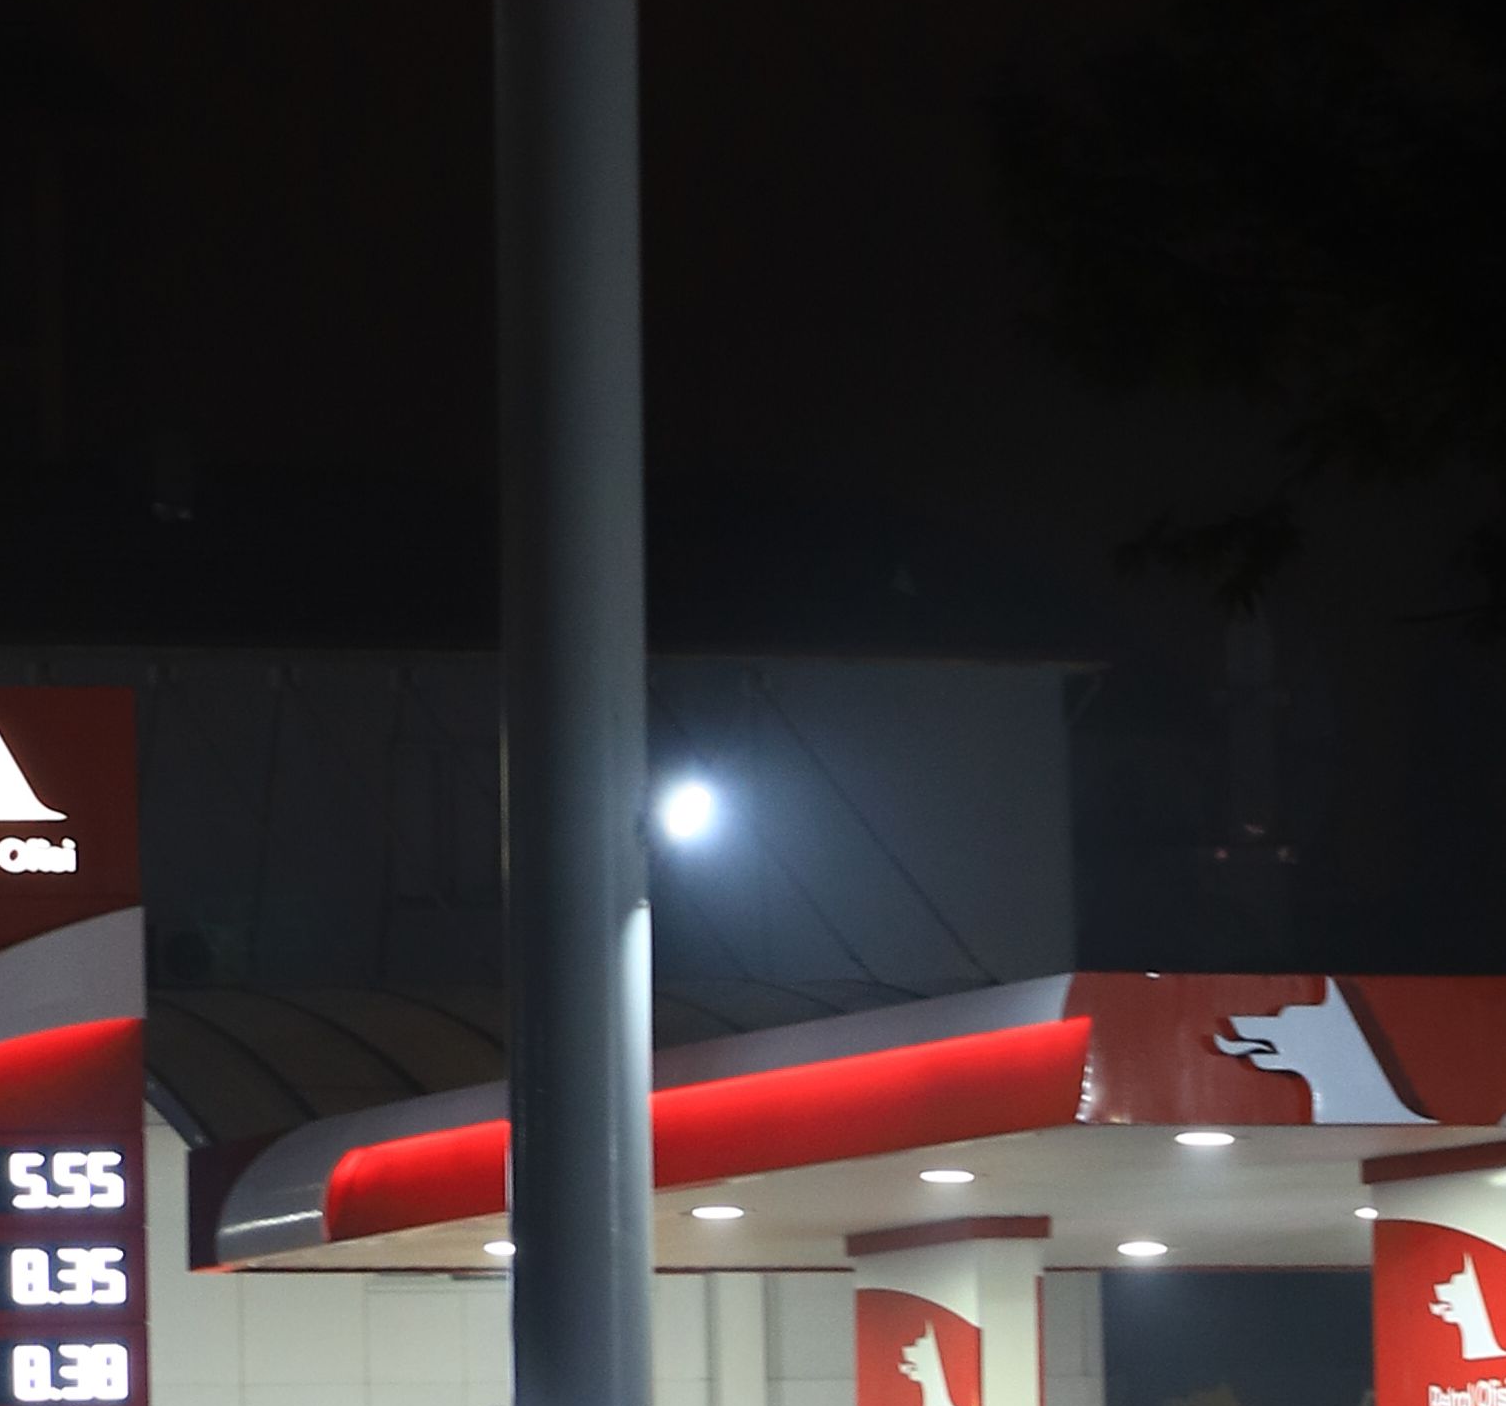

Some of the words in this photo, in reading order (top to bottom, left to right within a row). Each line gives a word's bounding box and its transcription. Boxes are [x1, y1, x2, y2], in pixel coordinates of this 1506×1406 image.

[9, 1151, 125, 1209] 5.55
[11, 1247, 127, 1305] 8.35
[12, 1343, 129, 1401] 8.38
